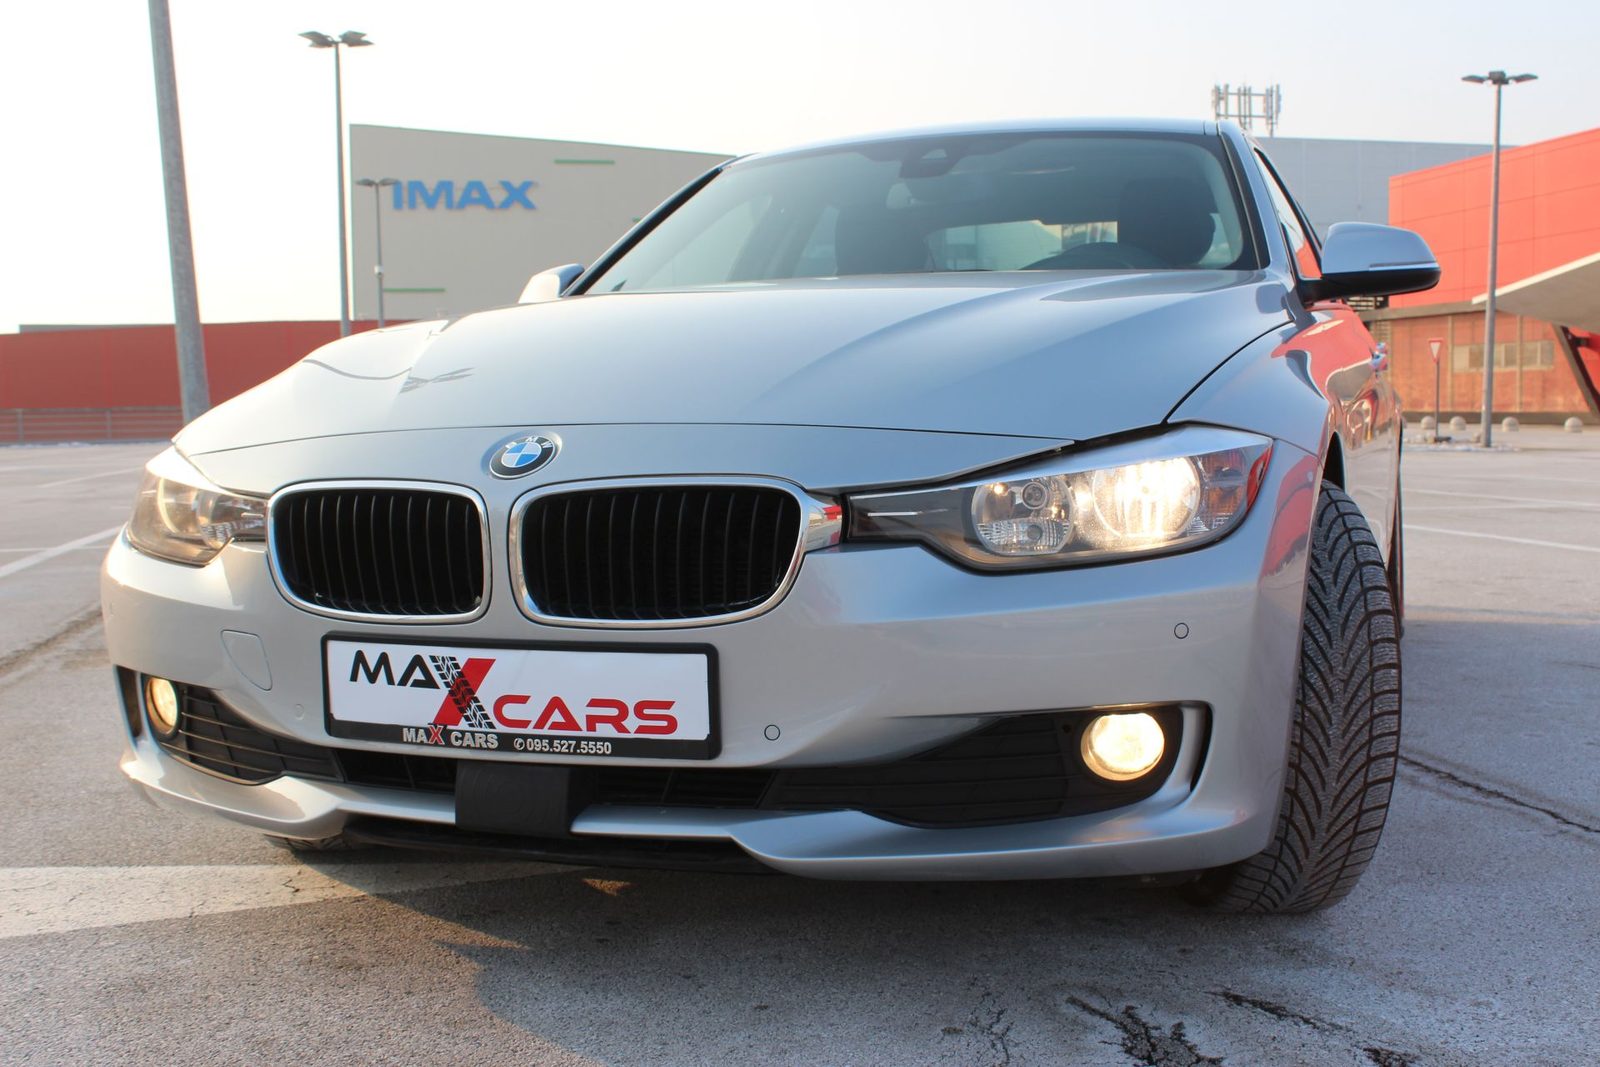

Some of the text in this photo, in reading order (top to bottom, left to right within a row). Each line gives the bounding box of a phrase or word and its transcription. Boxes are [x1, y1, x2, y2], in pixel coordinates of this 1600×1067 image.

[392, 179, 537, 210] IMAX
[505, 435, 554, 449] BMW
[349, 649, 678, 735] MAX CARS
[403, 725, 612, 755] MAX CARS 095.527.5550
